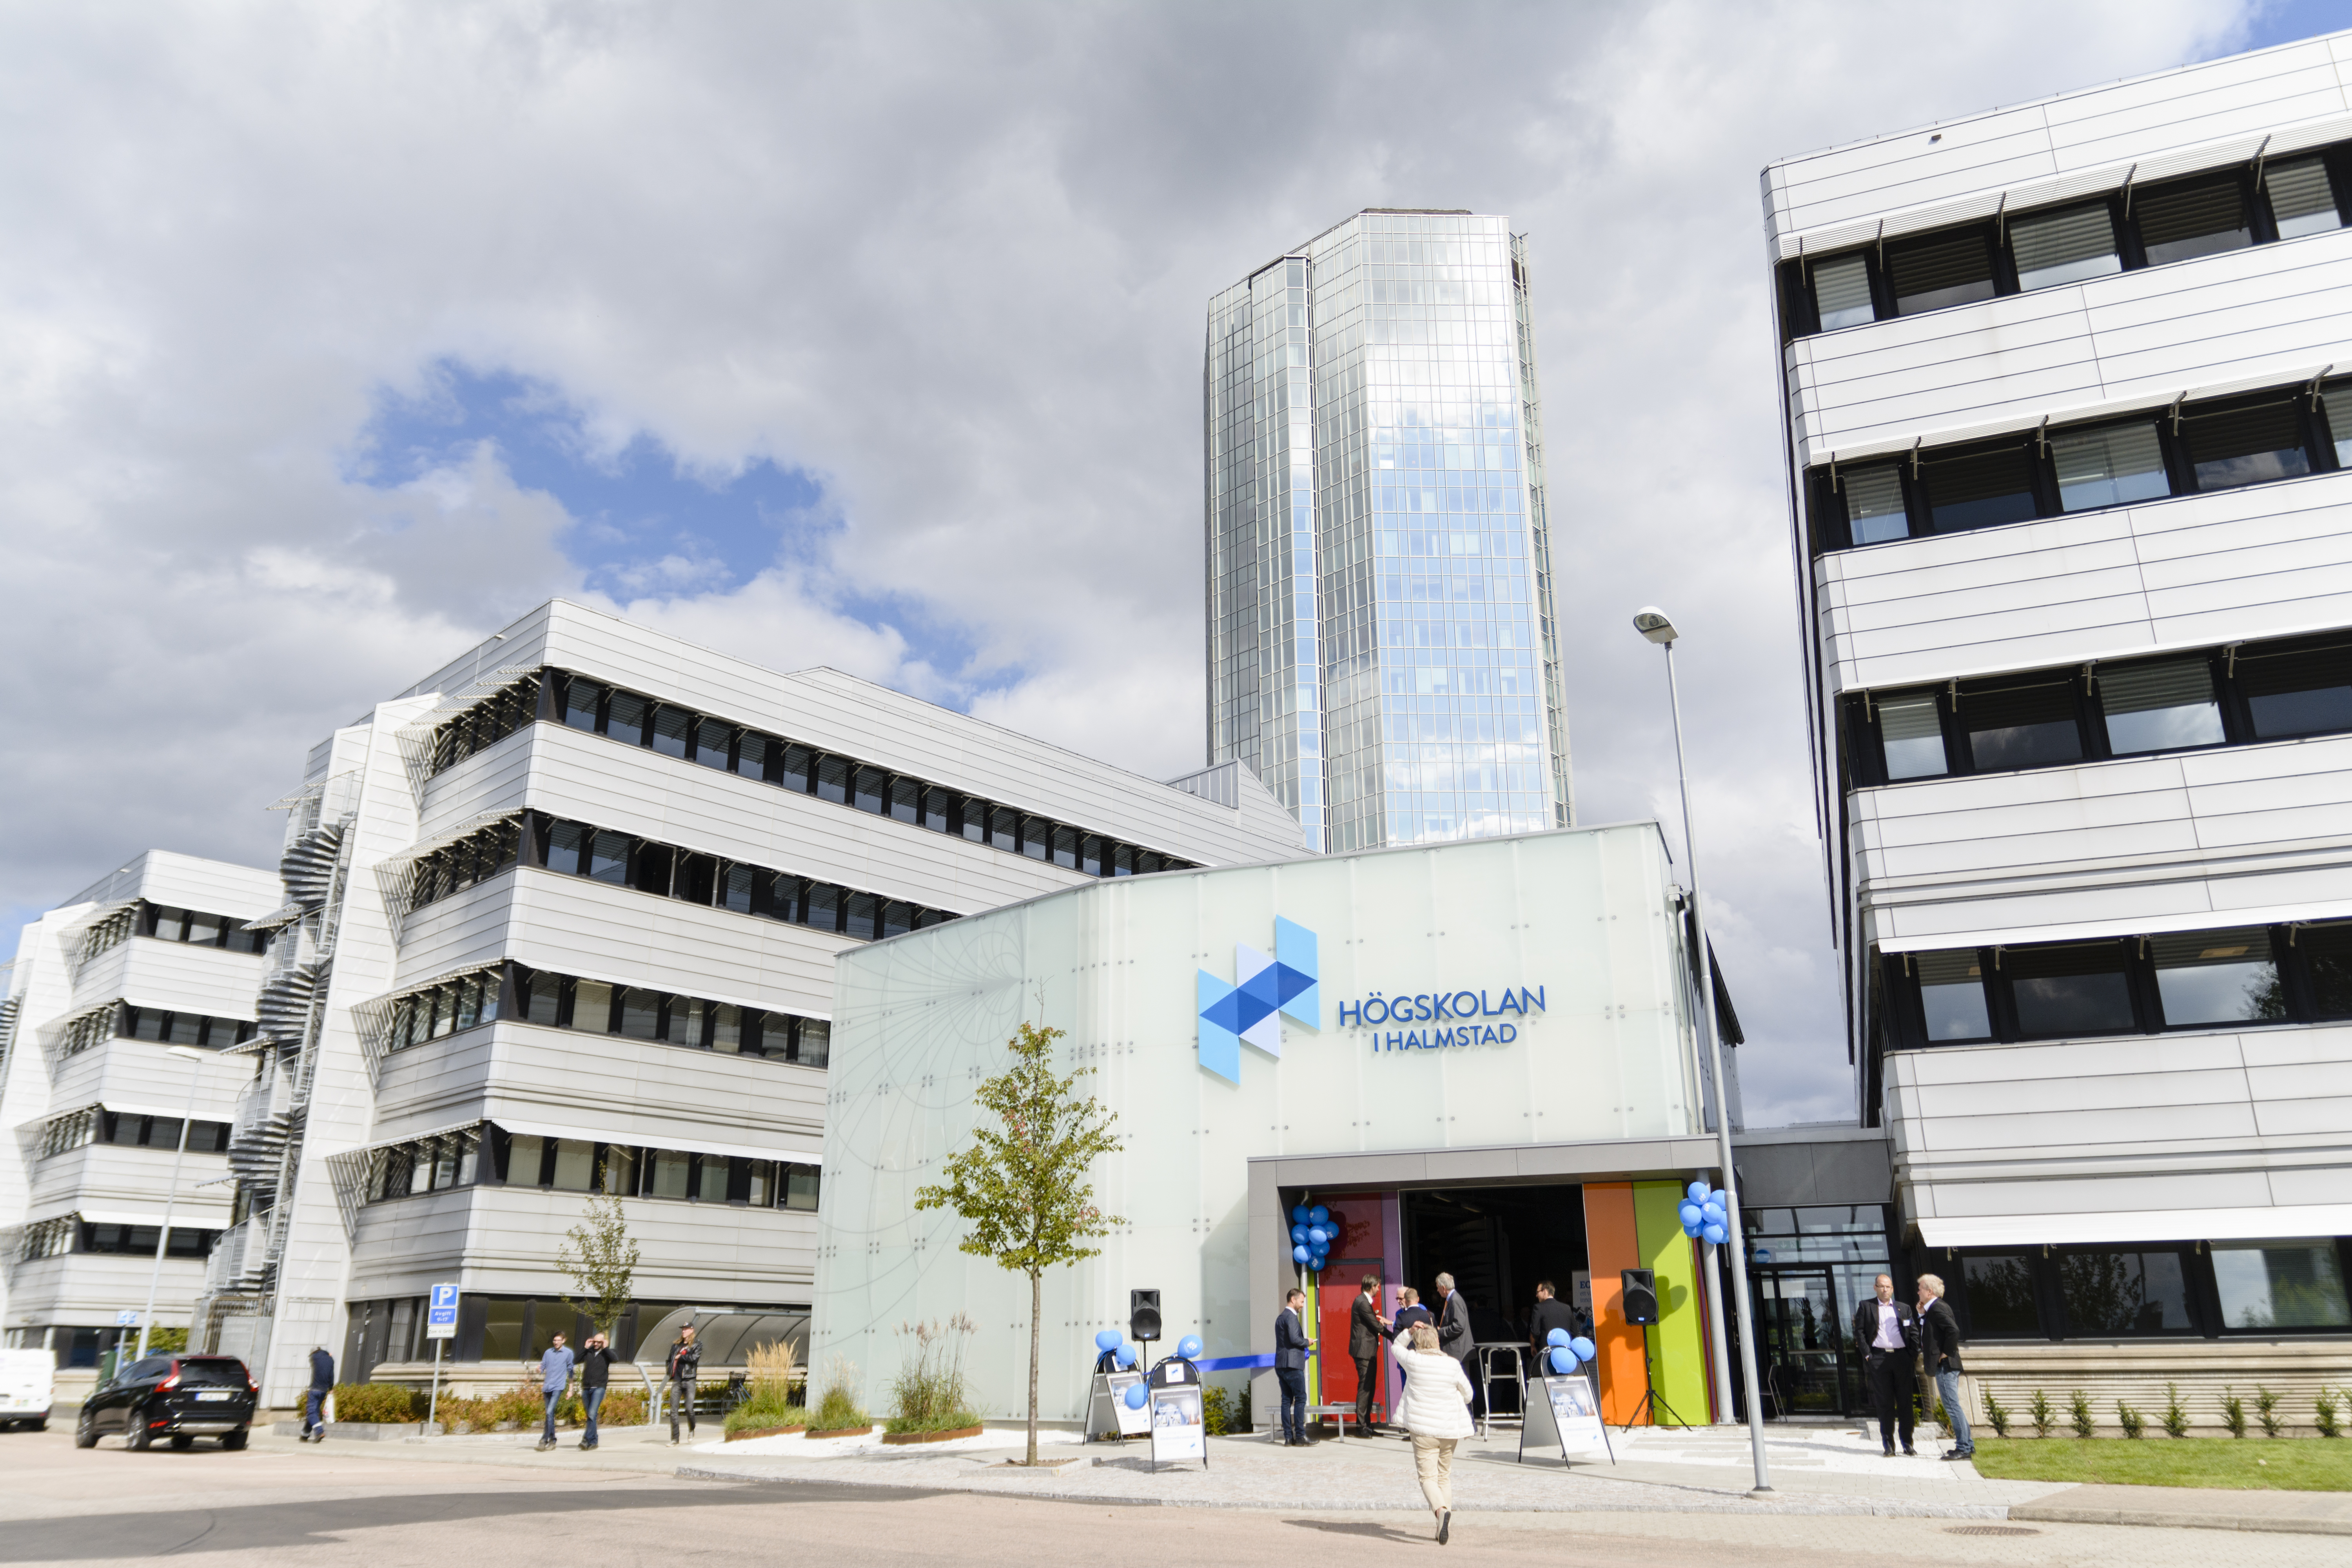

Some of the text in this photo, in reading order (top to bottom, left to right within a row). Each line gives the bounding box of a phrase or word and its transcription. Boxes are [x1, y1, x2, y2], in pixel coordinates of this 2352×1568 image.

[1339, 985, 1546, 1026] HÖGSKOLAN
[1374, 1023, 1517, 1052] I HALMSTAD
[438, 1287, 452, 1305] P
